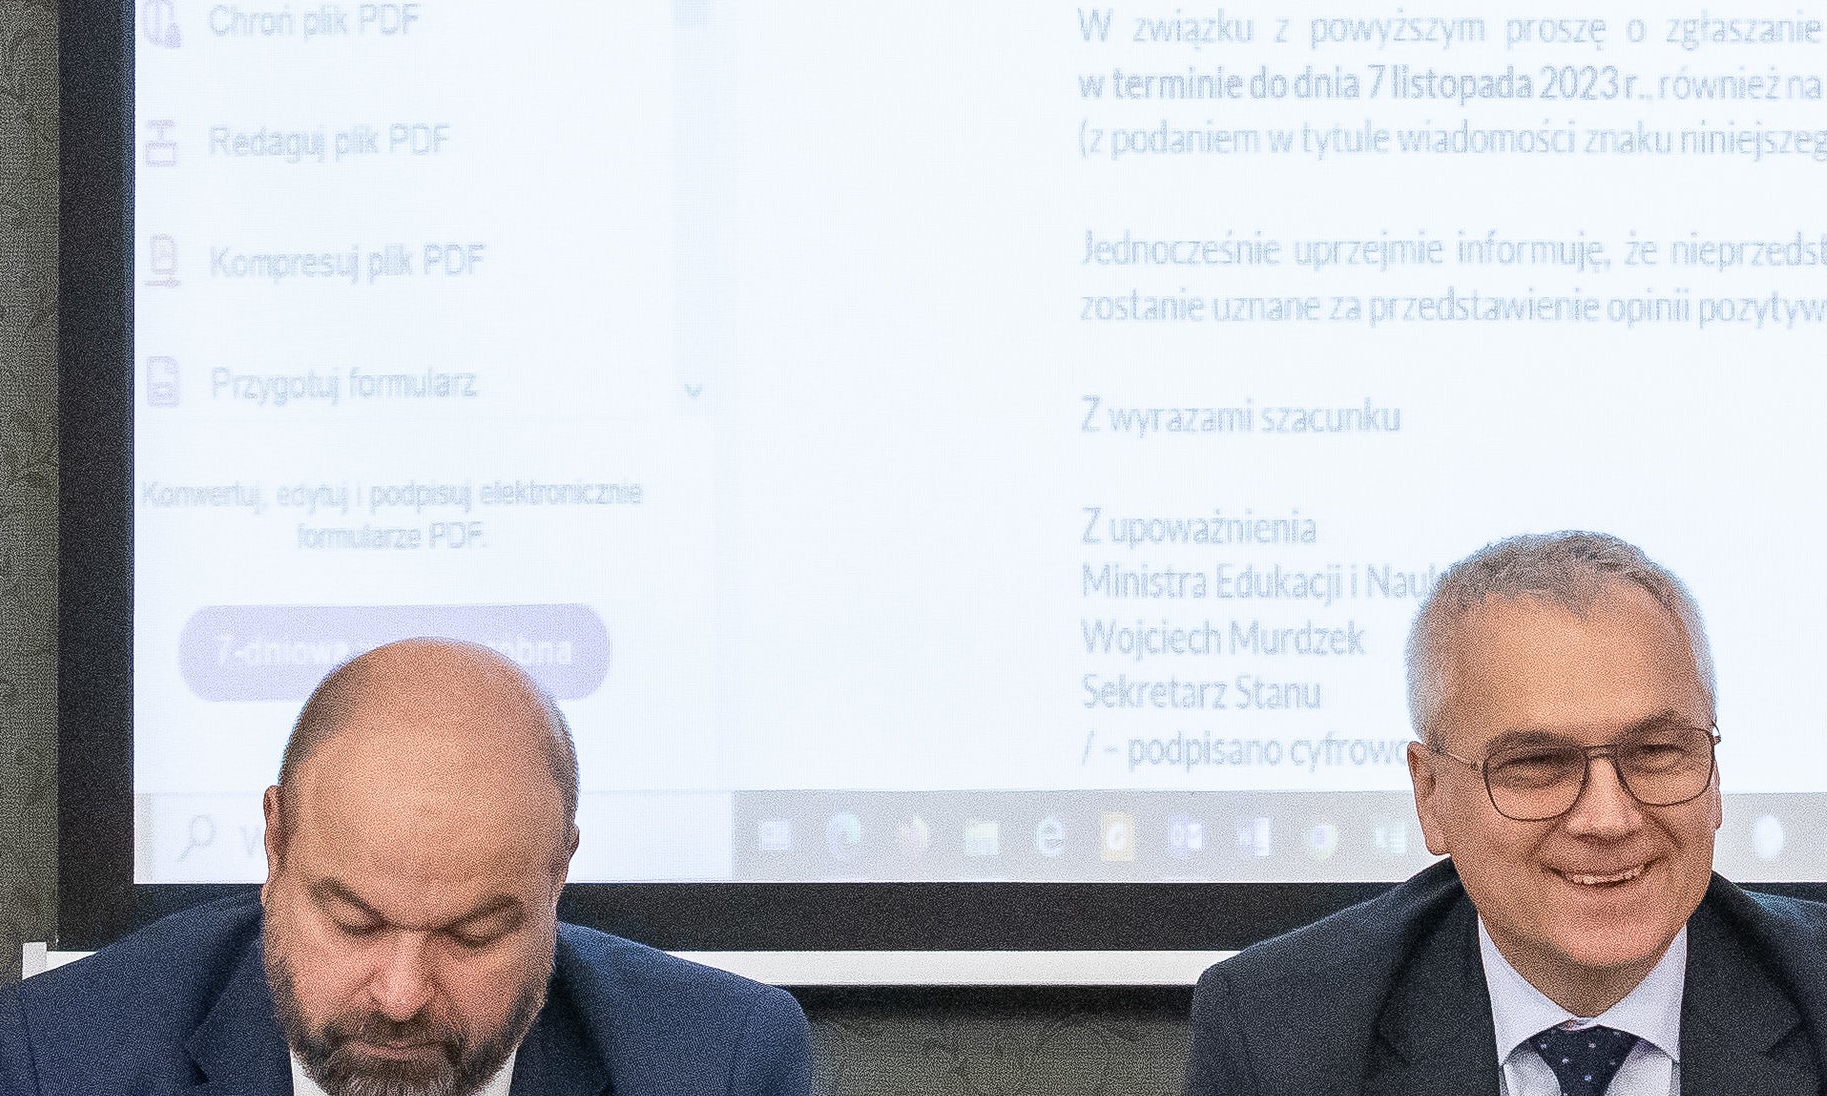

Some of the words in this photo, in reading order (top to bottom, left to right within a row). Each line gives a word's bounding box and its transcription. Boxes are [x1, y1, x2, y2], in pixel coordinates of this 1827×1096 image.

[208, 4, 295, 38] Chroń
[303, 4, 349, 45] plik
[358, 2, 420, 36] PDF
[1077, 7, 1113, 42] W
[1133, 8, 1254, 51] związku
[1274, 18, 1290, 43] z
[1310, 9, 1486, 51] powyższym
[1506, 18, 1607, 51] proszę
[1626, 18, 1646, 43] o
[1666, 10, 1823, 52] zgłaszanie
[1078, 74, 1105, 100] w
[1112, 65, 1244, 100] terminie
[1249, 64, 1289, 100] do
[1293, 64, 1360, 99] dnia
[1367, 64, 1386, 99] 7
[1391, 64, 1534, 107] listopada
[1539, 64, 1619, 101] 2023
[1659, 65, 1780, 101] również
[1787, 74, 1822, 100] na
[209, 125, 327, 164] Redaguj
[334, 125, 379, 162] plik
[389, 122, 450, 156] PDF
[1079, 119, 1104, 158] (z
[1111, 119, 1260, 161] podaniem
[1267, 130, 1294, 153] w
[1301, 119, 1391, 161] tytule
[1397, 118, 1576, 154] wiadomości
[1583, 120, 1673, 154] znaku
[210, 244, 361, 285] Kompresuj
[367, 244, 414, 285] plik
[423, 242, 487, 276] PDF
[1082, 229, 1281, 266] Jednocześnie
[1294, 229, 1445, 272] uprzejmie
[1457, 229, 1612, 273] informuję,
[1624, 230, 1658, 267] że
[1080, 287, 1206, 322] zostanie
[1212, 296, 1321, 322] uznane
[1329, 296, 1362, 321] za
[1369, 286, 1601, 328] przedstawienie
[1607, 287, 1690, 328] opinii
[211, 366, 341, 408] Przygotuj
[348, 366, 479, 399] formularz
[1081, 395, 1102, 433] Z
[1108, 398, 1254, 439] wyrazami
[1261, 397, 1401, 433] szacunku
[141, 480, 267, 514] Konwertuj,
[277, 483, 349, 514] edytuj
[355, 484, 364, 508] i
[369, 480, 473, 514] podpisuj
[479, 480, 644, 506] elektronicznie
[297, 523, 422, 550] formularze
[428, 520, 487, 549] PDF.
[1081, 506, 1102, 545] Z
[1109, 508, 1317, 550] upoważnienia
[1082, 563, 1208, 599] Ministra
[1216, 563, 1342, 607] Edukacji
[1351, 564, 1357, 598] i
[1081, 619, 1222, 662] Wojciech
[1229, 620, 1365, 656] Murdzek
[1082, 673, 1228, 710] Sekretarz
[1235, 674, 1321, 710] Stanu
[1128, 730, 1283, 773] podpisano
